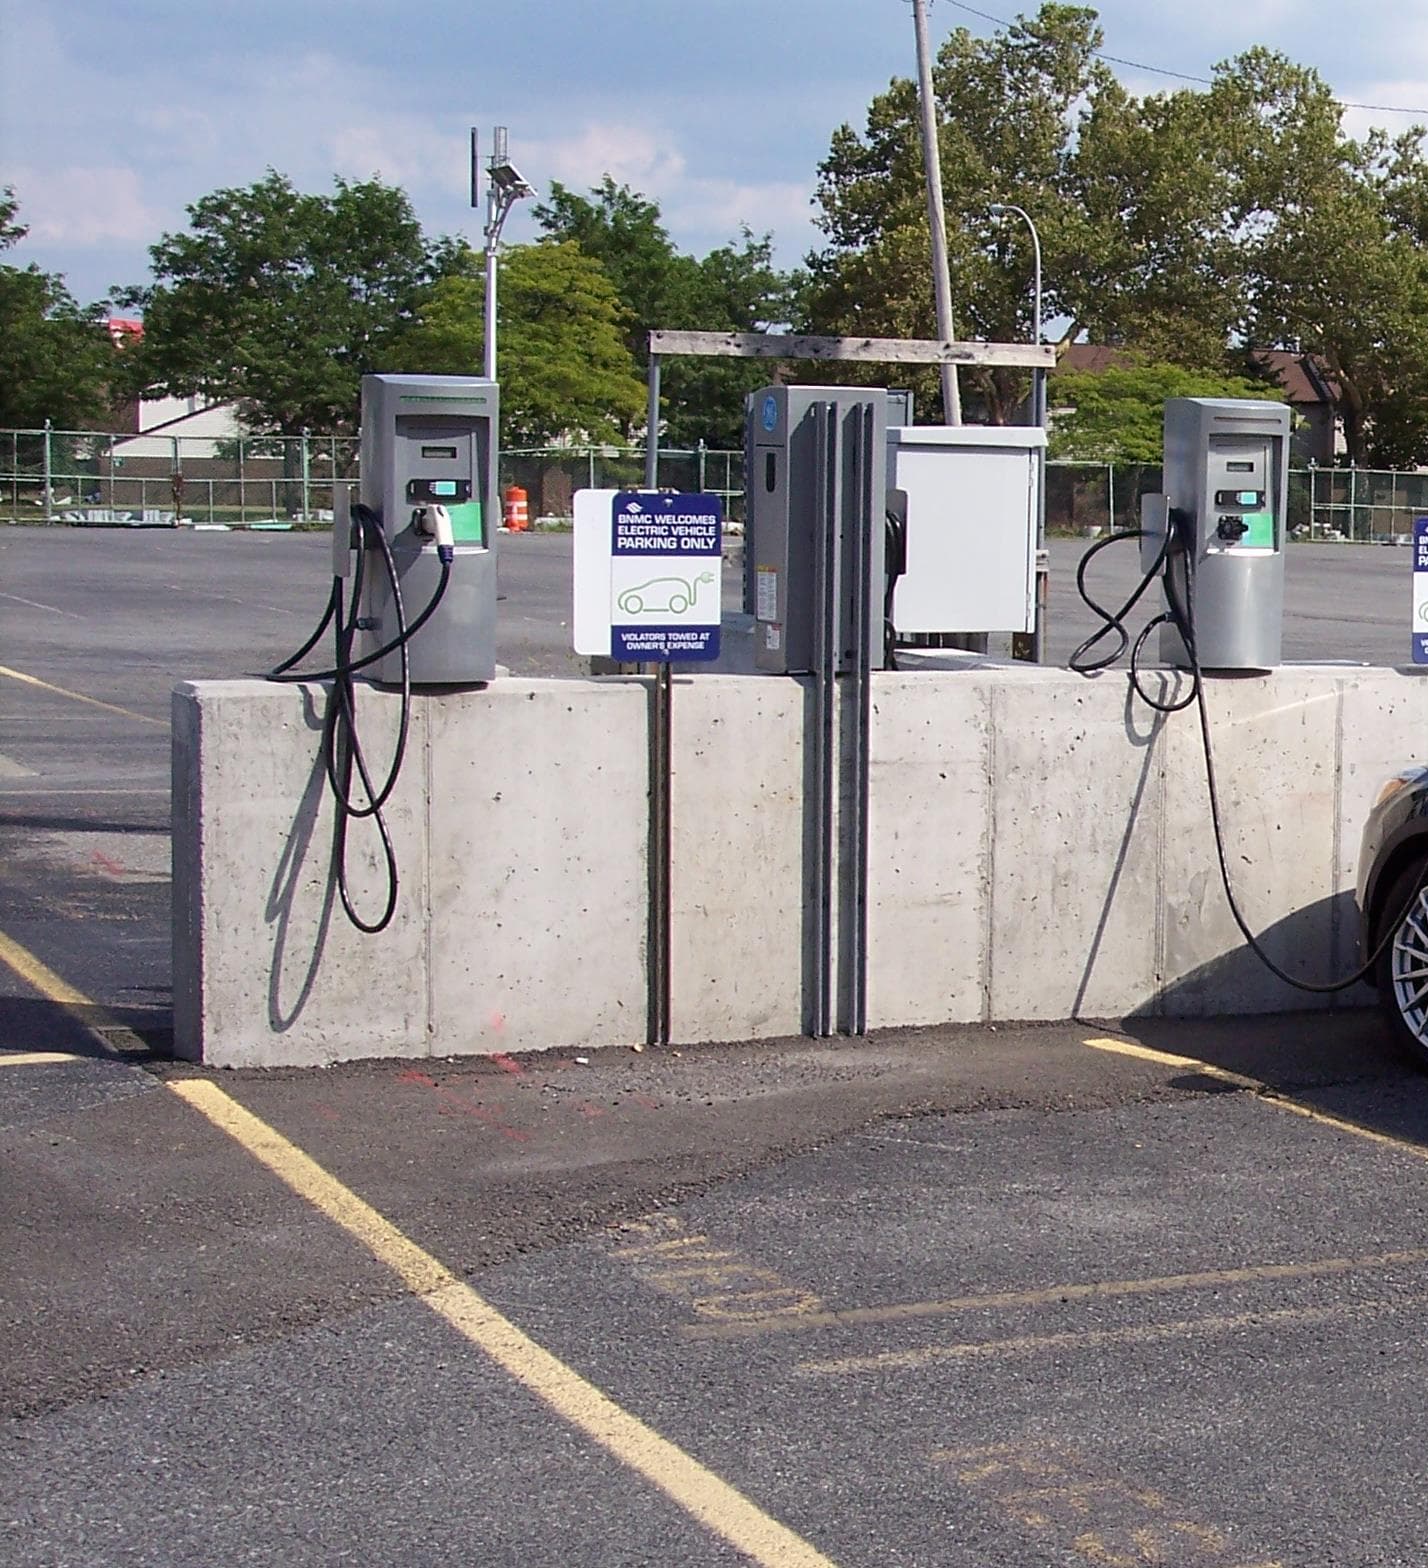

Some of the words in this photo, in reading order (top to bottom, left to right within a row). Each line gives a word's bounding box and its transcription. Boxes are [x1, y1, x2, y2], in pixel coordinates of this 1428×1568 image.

[618, 515, 651, 524] BNMC
[655, 515, 716, 525] WELCOMES
[618, 526, 668, 536] ELECTRIC
[671, 526, 716, 536] VEHICLE
[618, 537, 677, 549] PARKING
[681, 537, 716, 549] ONLY
[621, 633, 666, 641] VIOLATORS
[668, 633, 697, 641] TOWED
[700, 632, 710, 640] AT
[667, 641, 704, 649] EXPENSE
